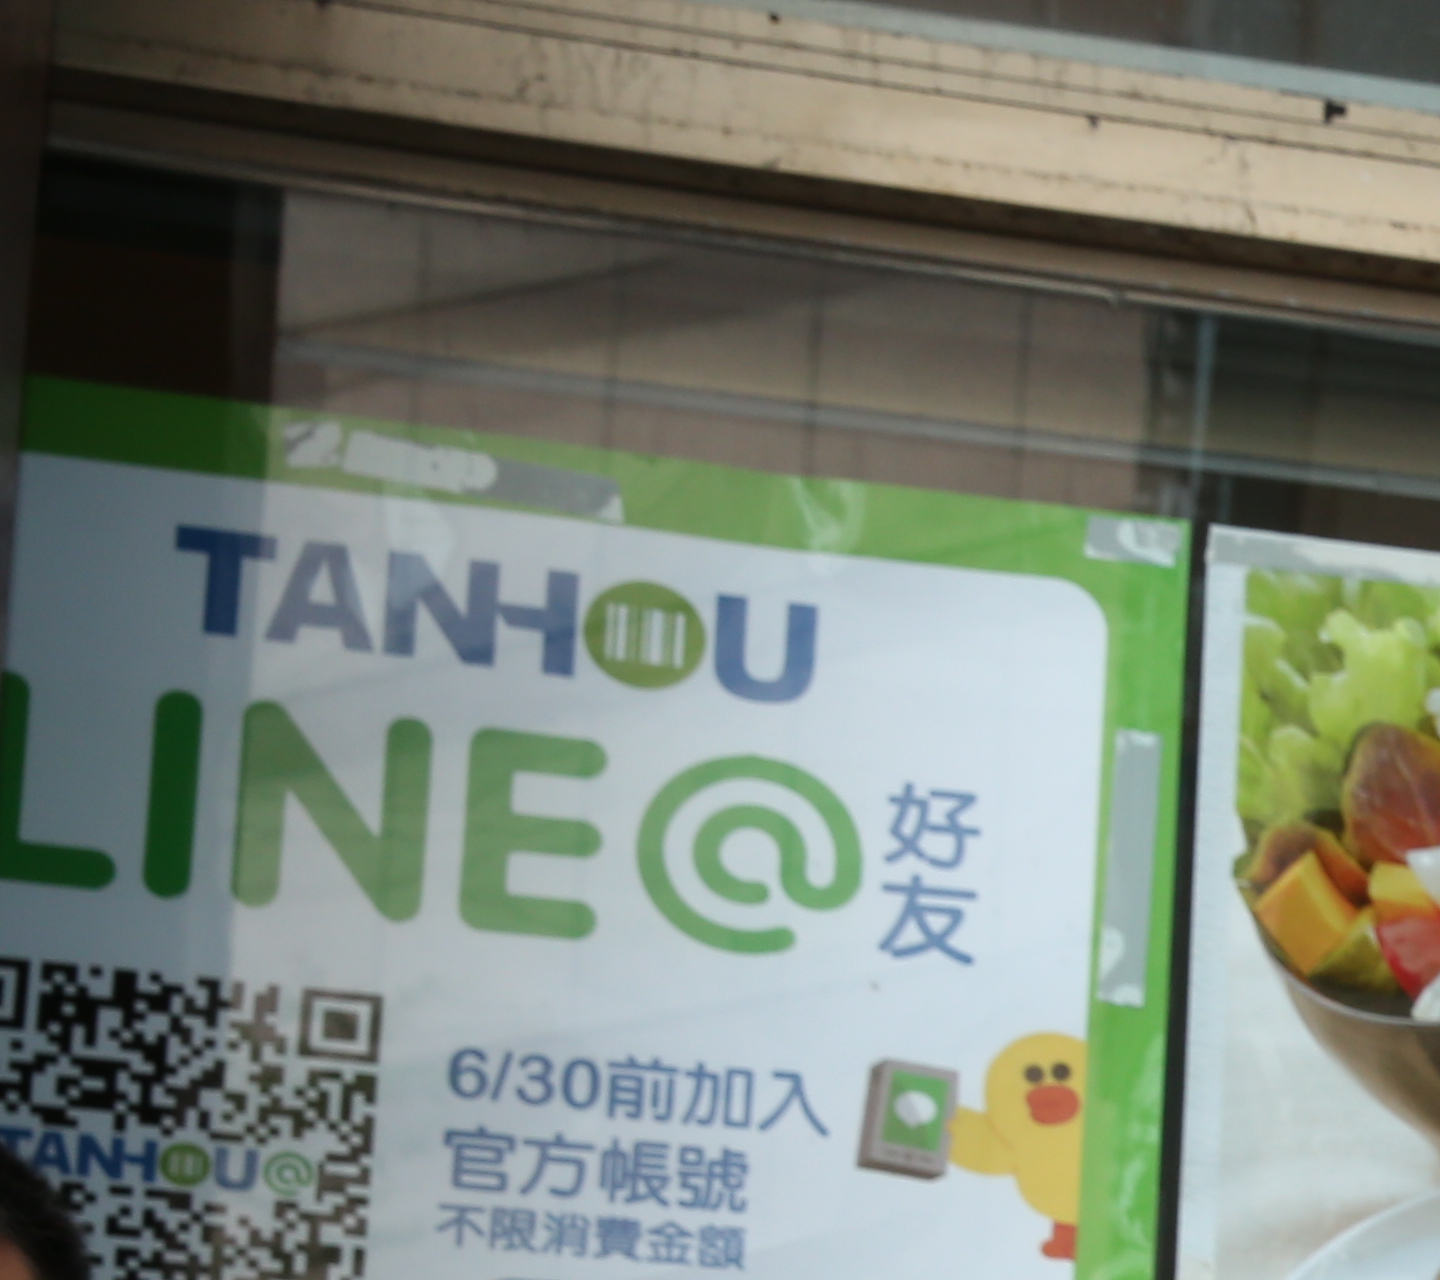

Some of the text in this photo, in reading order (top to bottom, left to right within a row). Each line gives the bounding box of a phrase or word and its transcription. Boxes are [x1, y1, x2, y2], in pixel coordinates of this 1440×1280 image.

[879, 783, 981, 966] 好友
[448, 1047, 830, 1138] 6/30前加入
[443, 1126, 750, 1213] 官方帳號
[435, 1203, 747, 1272] 不限消費金額
